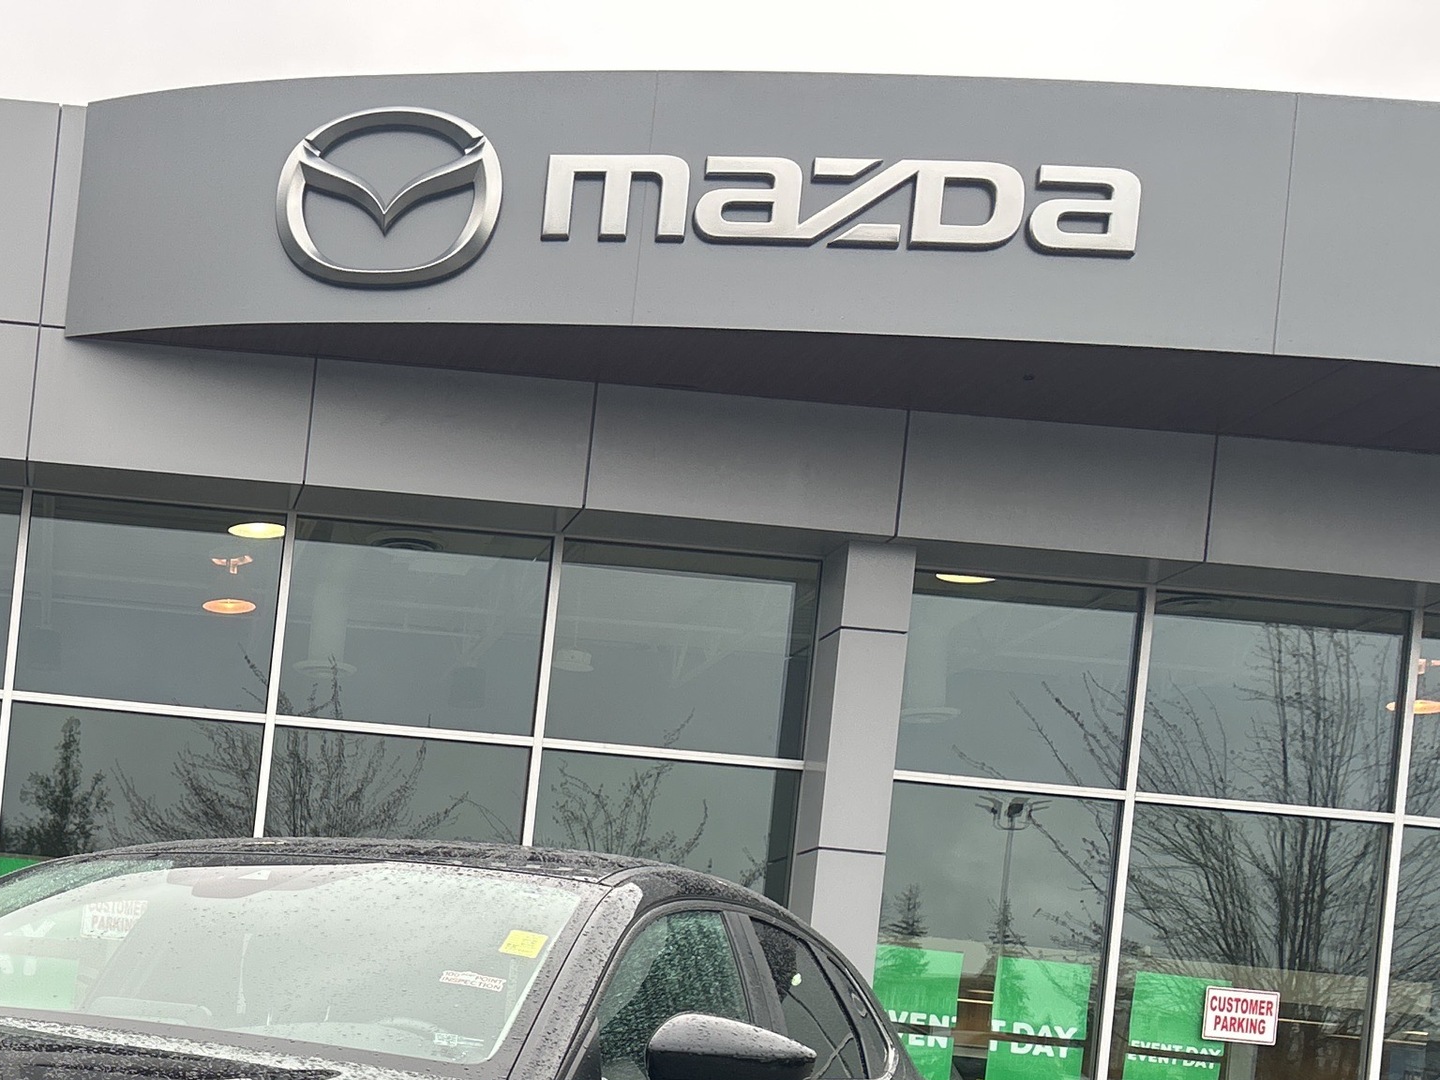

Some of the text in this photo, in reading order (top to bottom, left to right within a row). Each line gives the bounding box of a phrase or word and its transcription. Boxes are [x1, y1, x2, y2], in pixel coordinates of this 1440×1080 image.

[442, 976, 502, 990] INSPECTION
[1210, 995, 1274, 1017] CUSTOMER
[1214, 1014, 1266, 1035] PARKING
